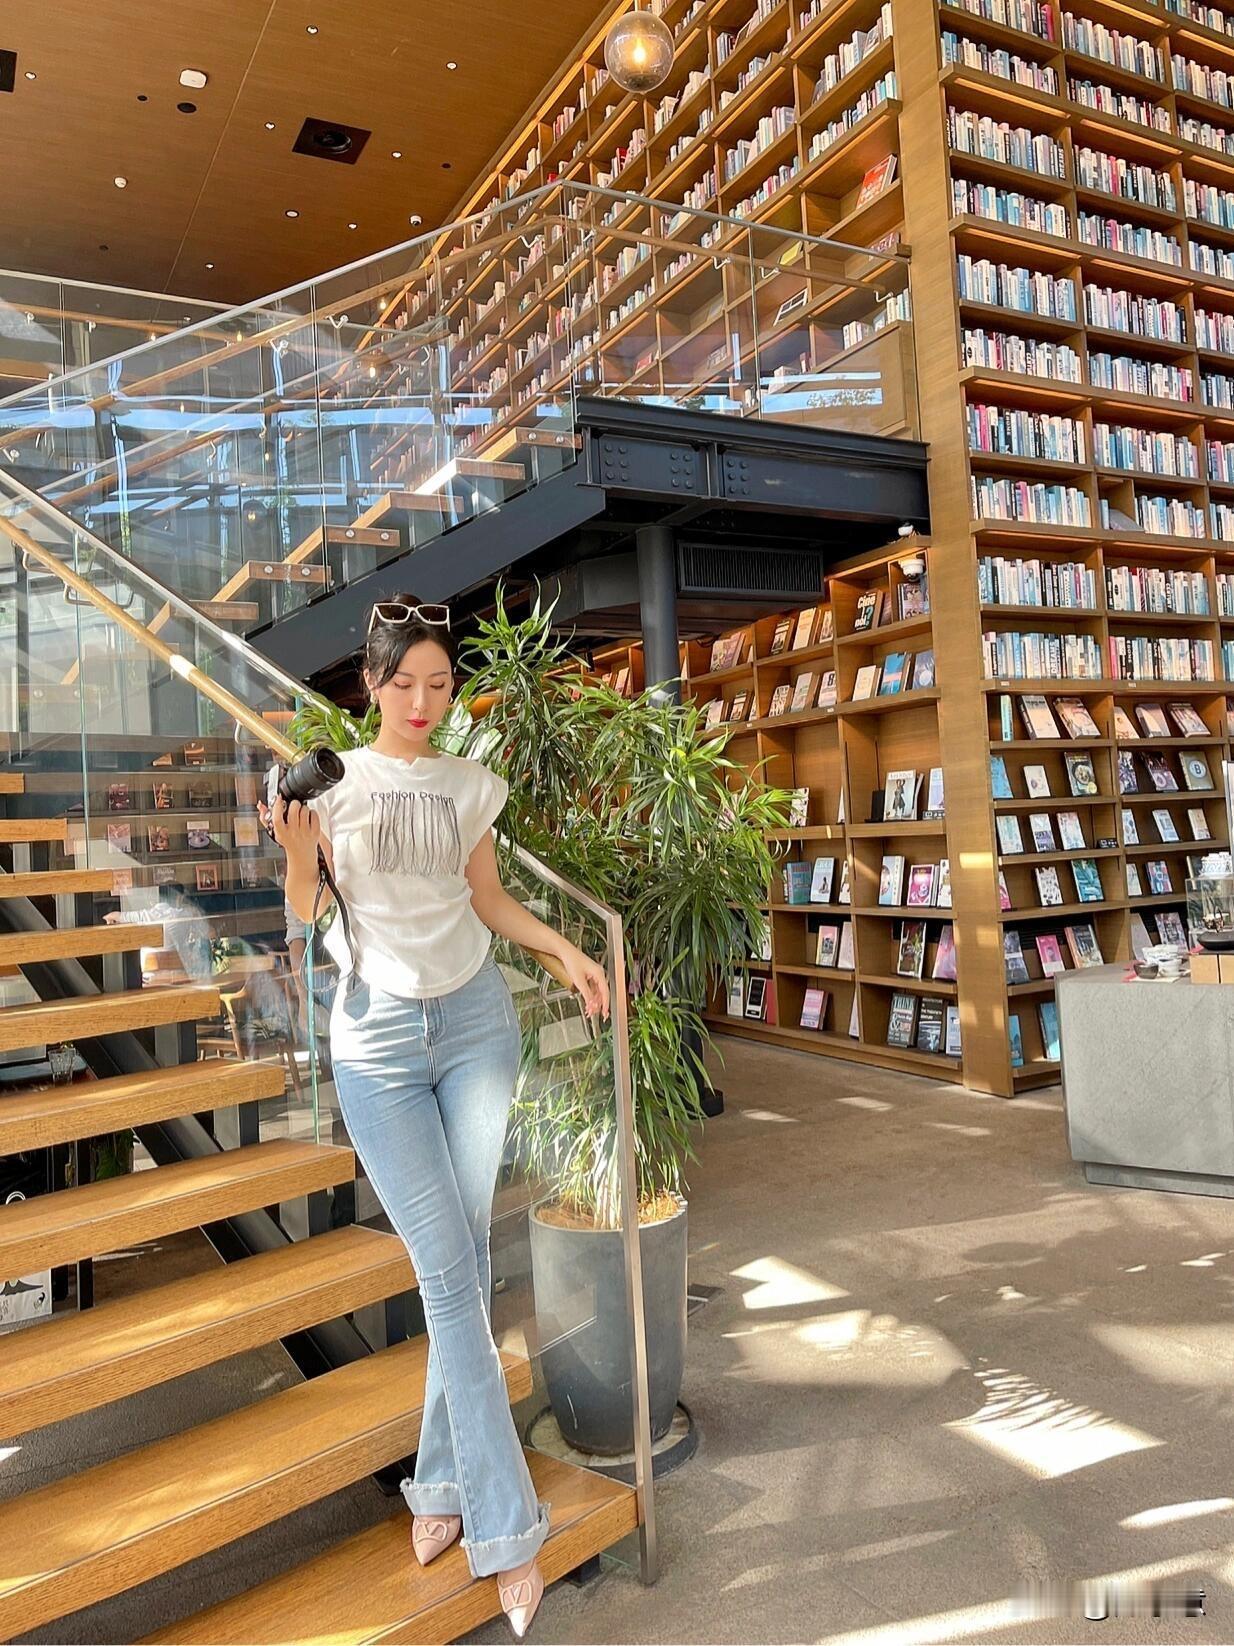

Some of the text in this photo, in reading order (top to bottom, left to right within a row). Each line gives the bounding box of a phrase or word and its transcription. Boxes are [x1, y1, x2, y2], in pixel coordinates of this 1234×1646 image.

[1194, 764, 1202, 774] B
[371, 790, 454, 803] Fashion Design
